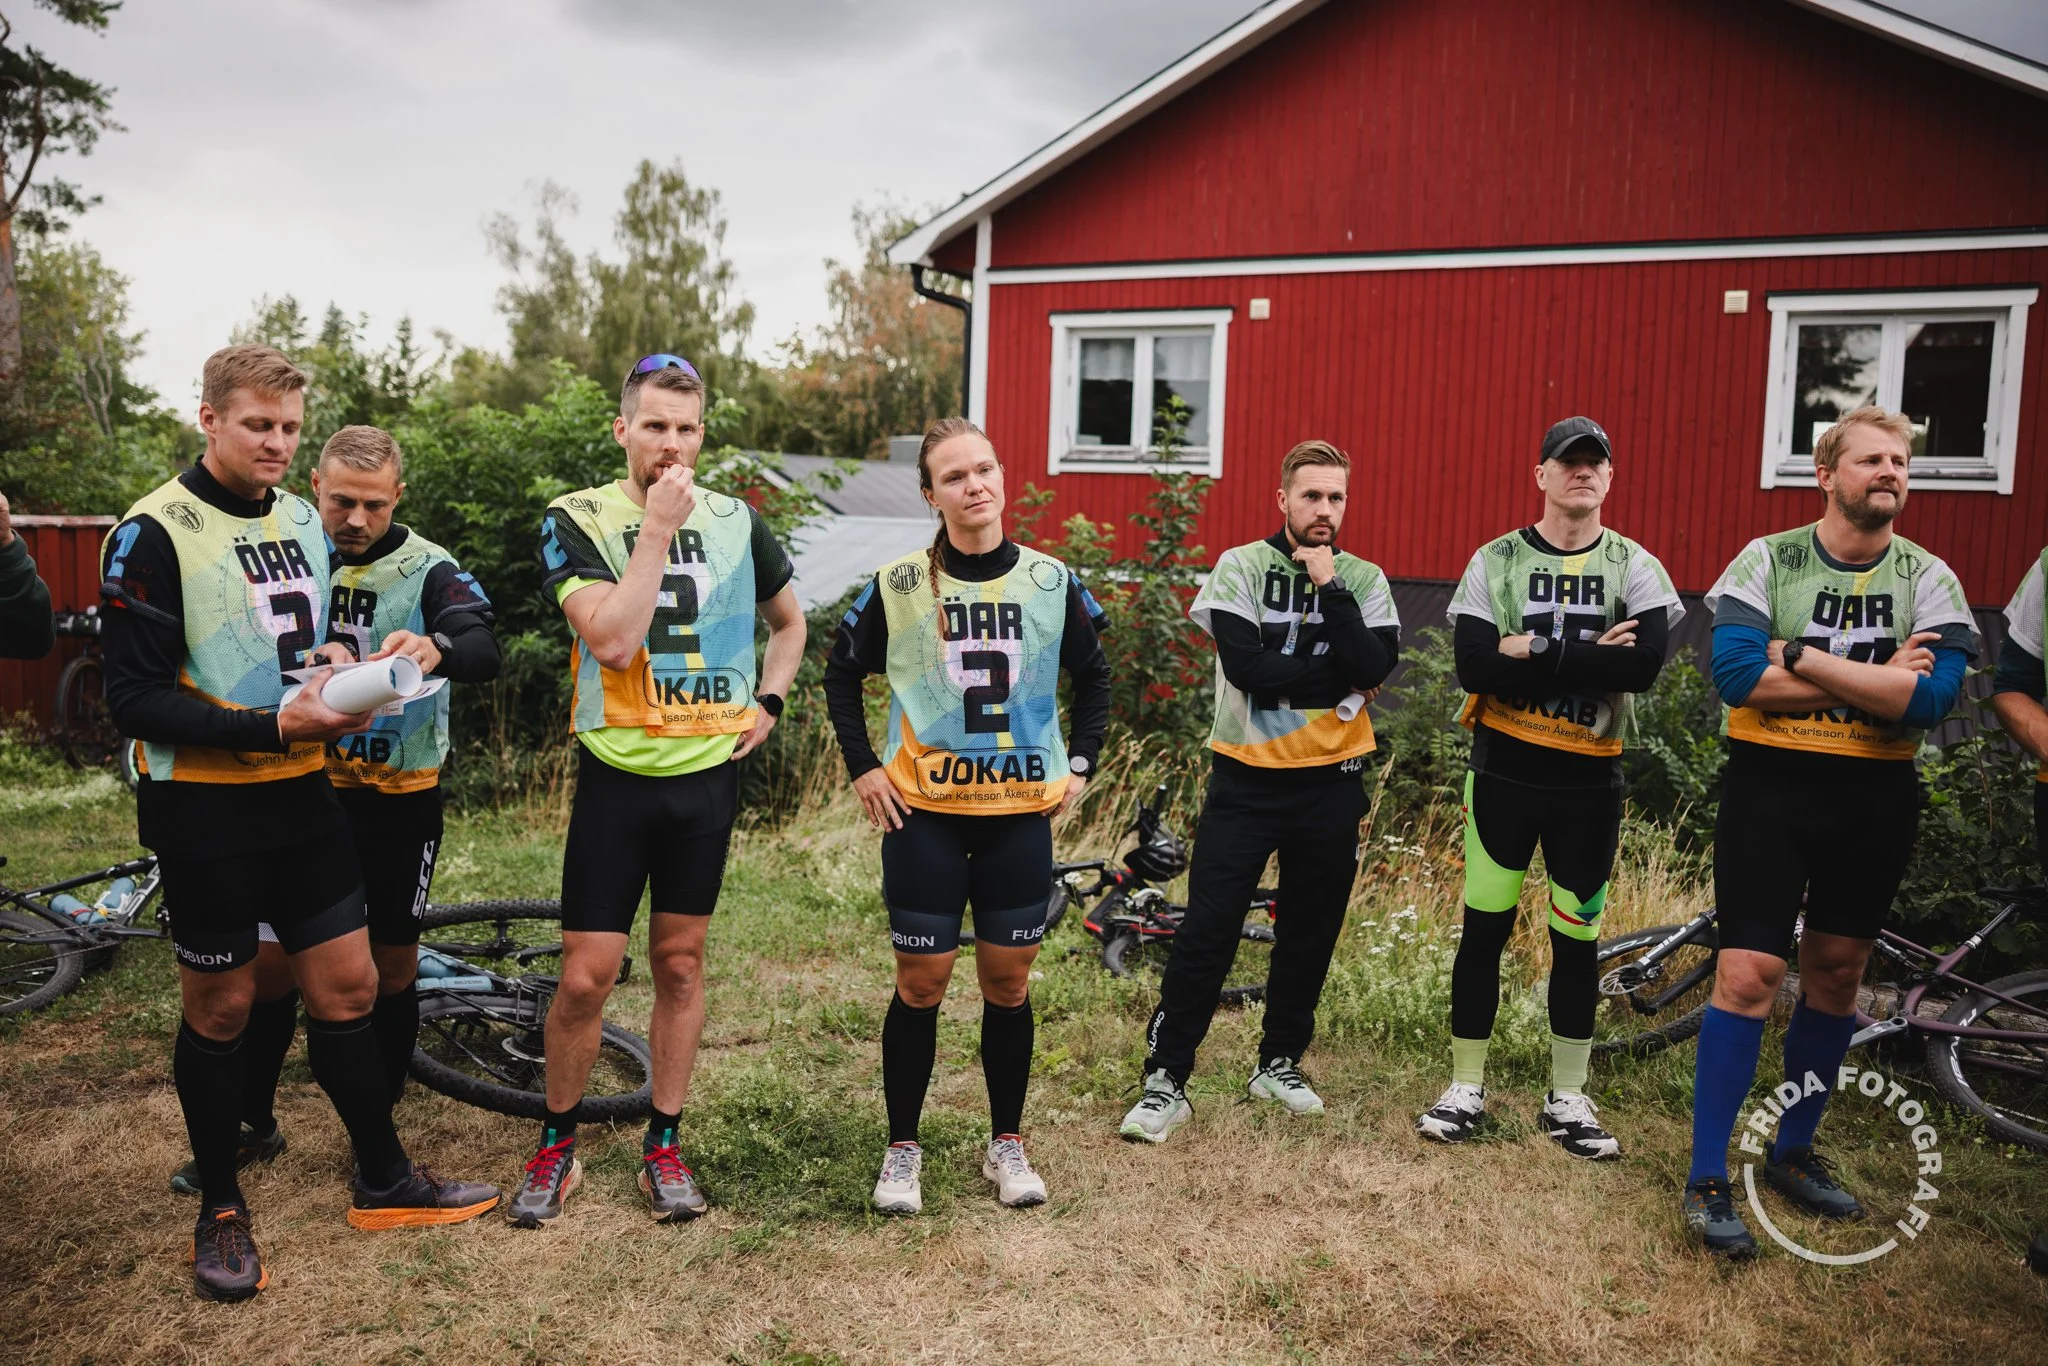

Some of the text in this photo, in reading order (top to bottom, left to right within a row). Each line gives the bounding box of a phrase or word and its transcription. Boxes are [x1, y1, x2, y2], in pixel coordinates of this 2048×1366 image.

[234, 536, 314, 585] ÖAR
[541, 516, 569, 570] 2
[1263, 564, 1316, 613] ÖA
[1529, 567, 1605, 607] ÖAR
[330, 585, 378, 628] AR
[650, 573, 701, 654] 2
[942, 596, 1023, 642] ÖAR
[1812, 586, 1894, 630] ÖAR
[268, 590, 316, 687] 2
[653, 675, 732, 705] KAB
[961, 650, 1011, 735] 2
[1511, 713, 1551, 733] Karlsson
[1792, 726, 1845, 739] Karlsson
[252, 753, 281, 768] John
[325, 735, 391, 764] KAB
[929, 754, 1046, 785] JOKAB
[927, 788, 952, 800] John
[956, 791, 1001, 801] Karlsson
[1004, 787, 1030, 799] Åkeri
[174, 942, 233, 965] FUSION
[890, 930, 935, 947] USION
[1149, 1011, 1165, 1048] CRAFT
